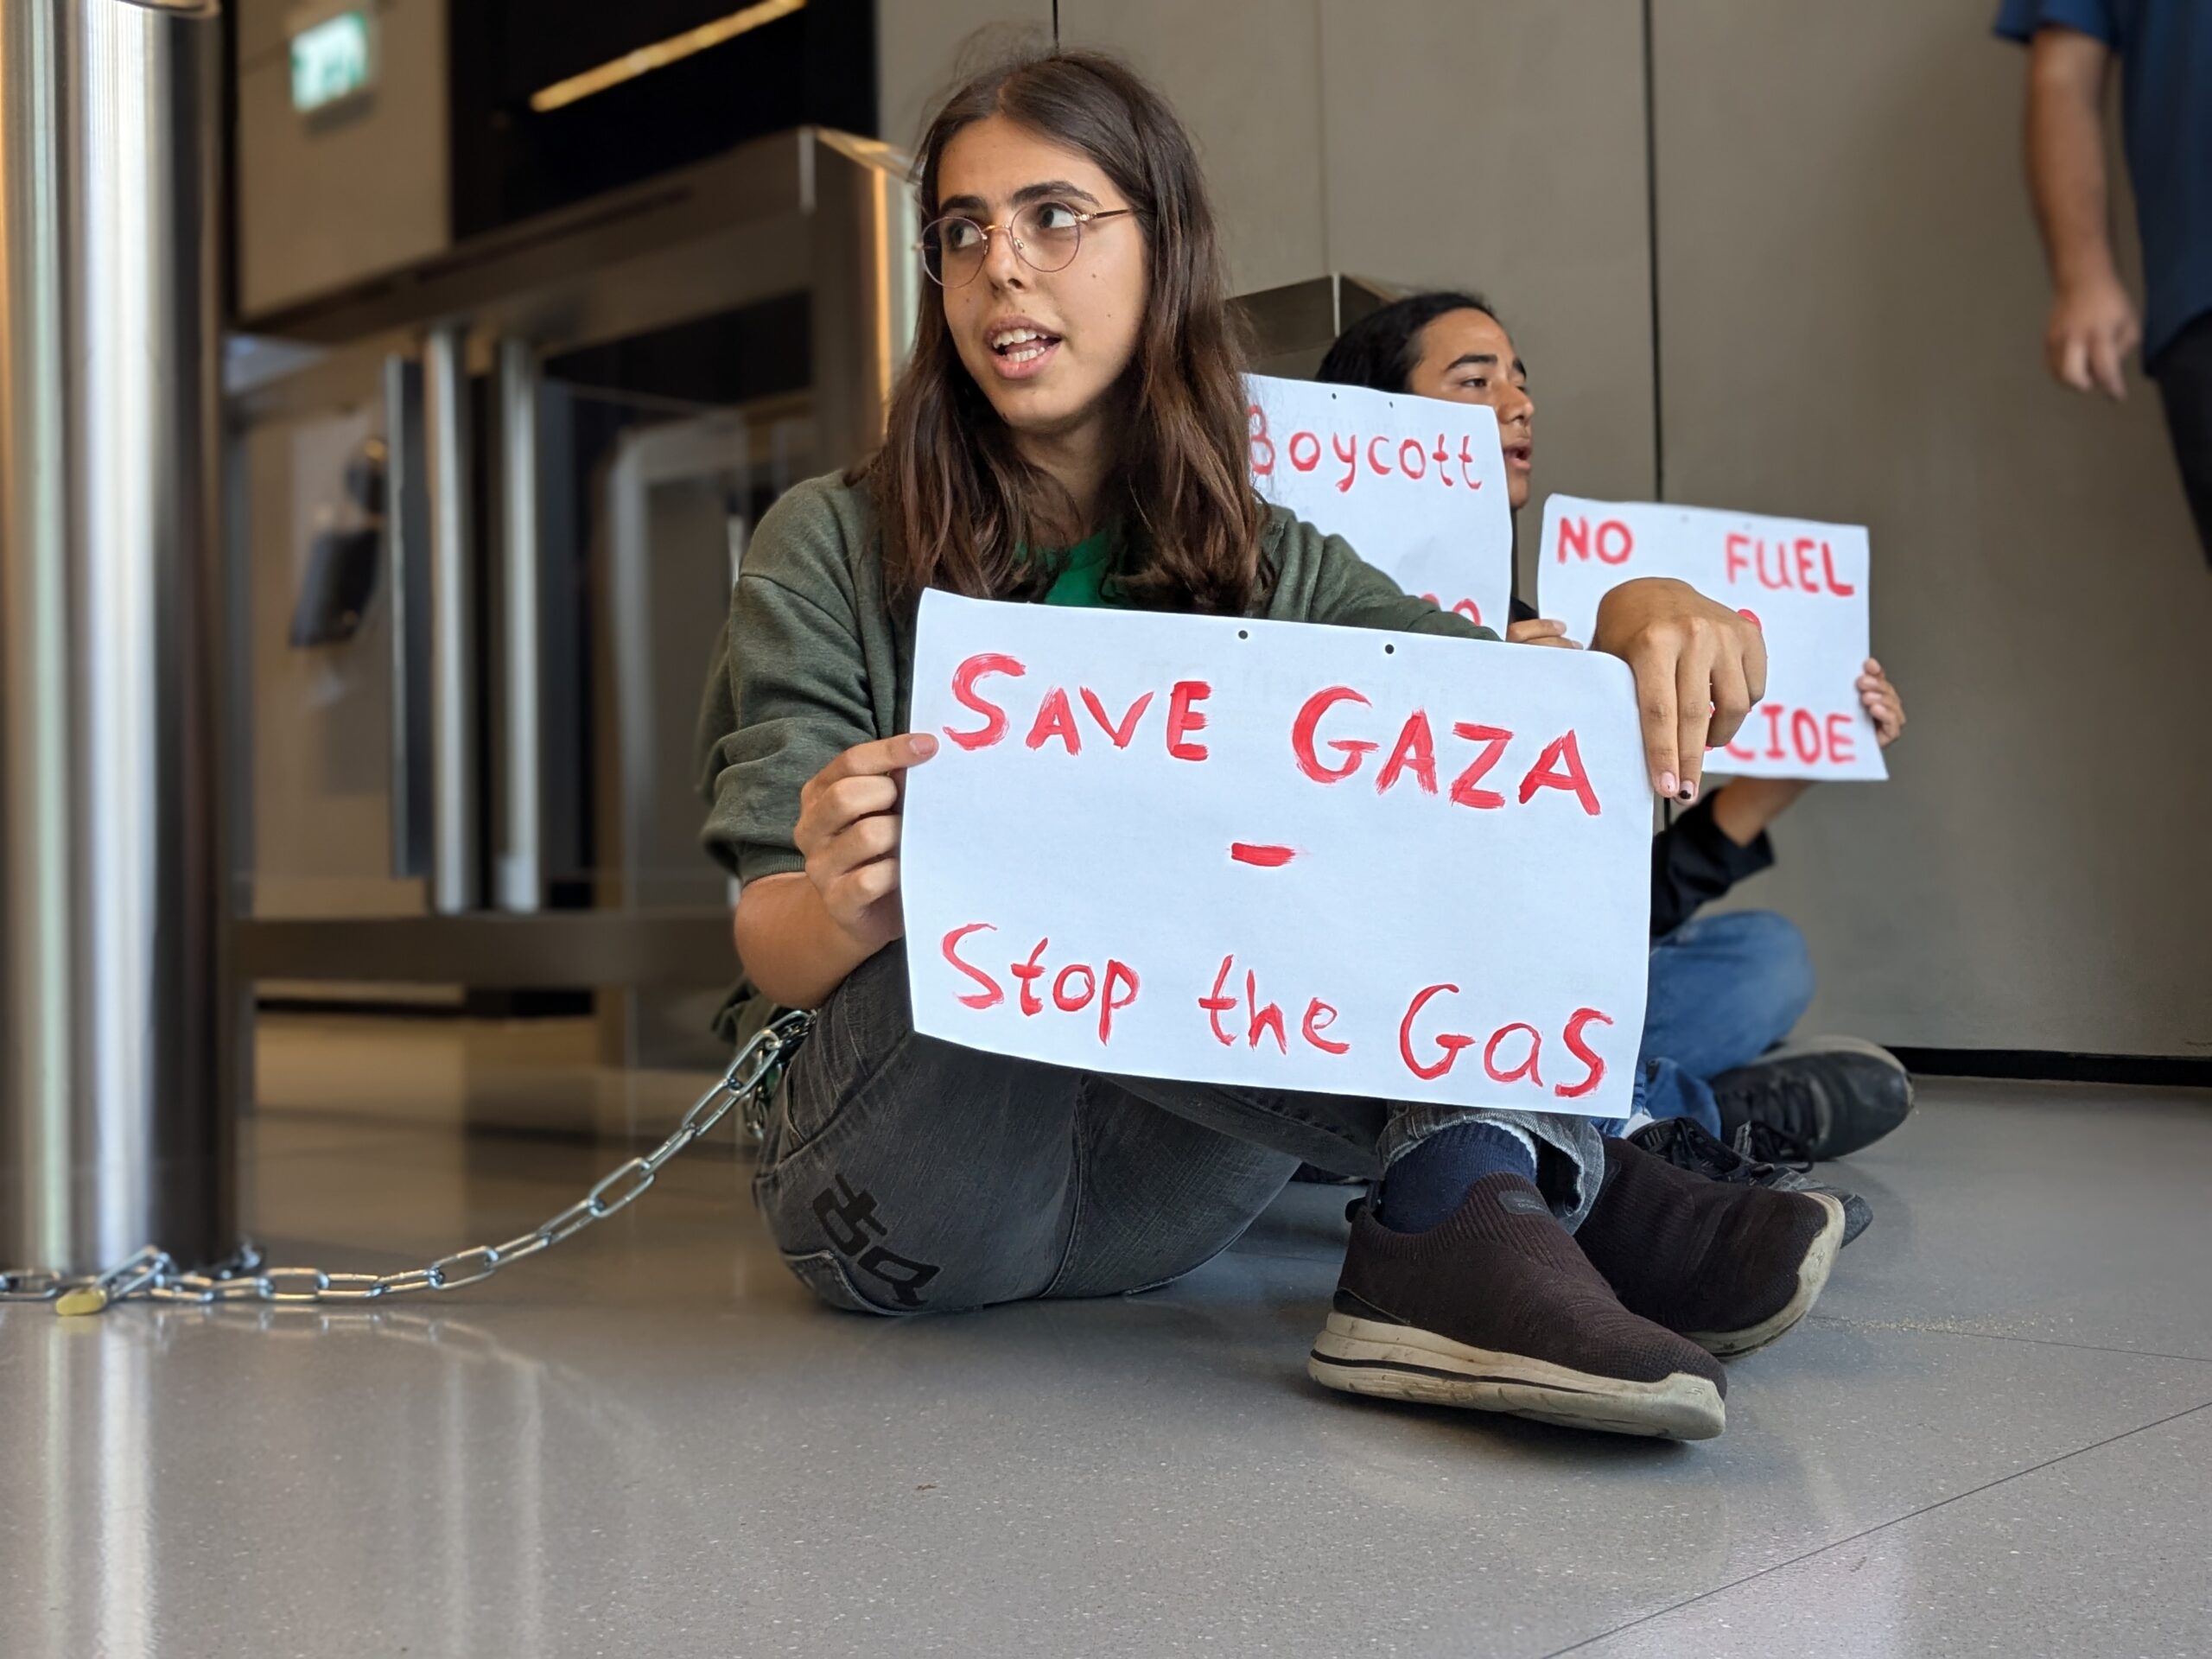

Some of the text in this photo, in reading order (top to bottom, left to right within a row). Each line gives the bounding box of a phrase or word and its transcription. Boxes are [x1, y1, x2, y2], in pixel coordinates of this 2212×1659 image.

[1249, 404, 1482, 493] Boycott
[1557, 516, 1854, 597] NO FUEL
[942, 652, 1602, 817] SAVE GAZA
[941, 923, 1615, 1098] Stop the Gas
